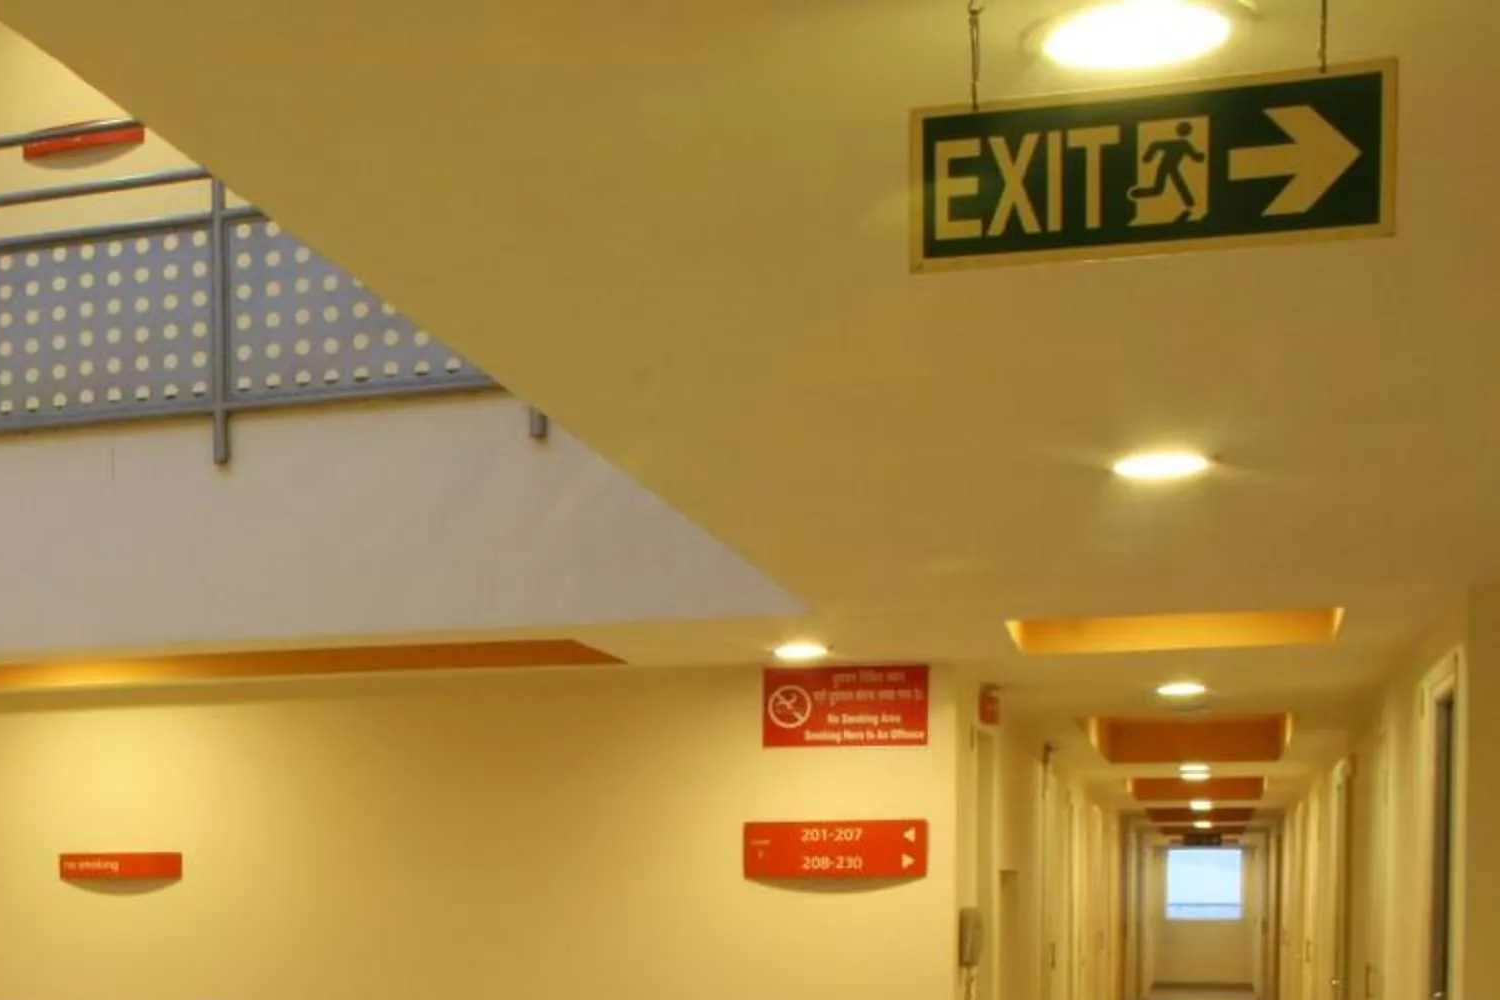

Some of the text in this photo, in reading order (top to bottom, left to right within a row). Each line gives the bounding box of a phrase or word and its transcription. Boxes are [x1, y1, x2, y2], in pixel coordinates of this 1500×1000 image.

[933, 124, 1122, 241] EXIT
[801, 828, 863, 842] 201-207
[802, 855, 863, 870] 208-230
